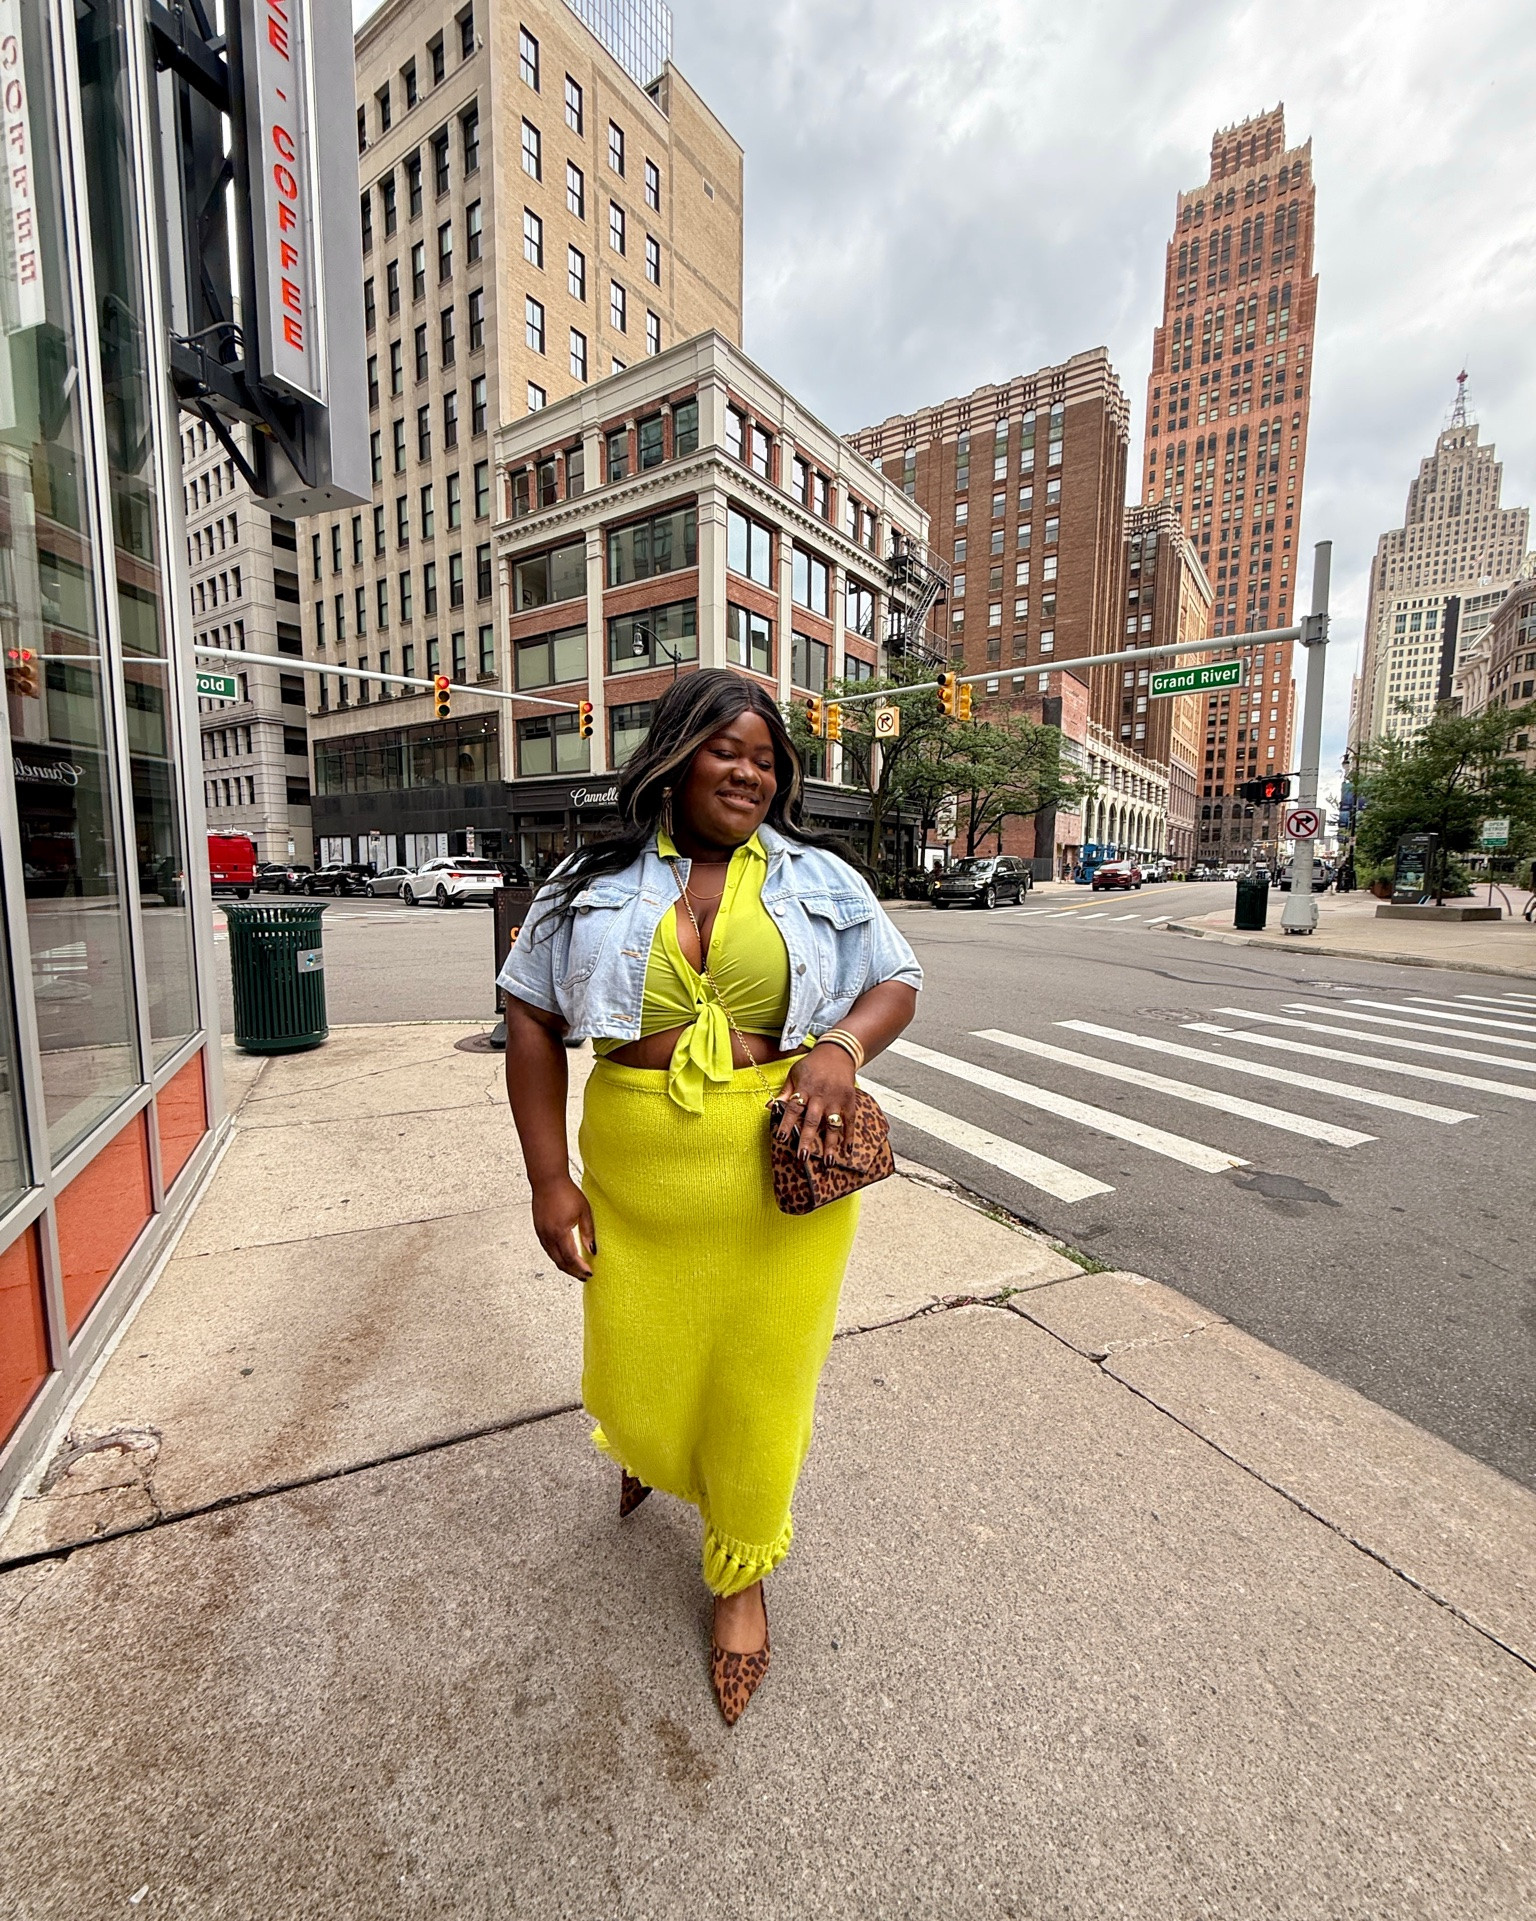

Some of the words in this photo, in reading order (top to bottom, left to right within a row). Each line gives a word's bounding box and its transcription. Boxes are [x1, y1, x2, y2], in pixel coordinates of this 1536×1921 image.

[272, 125, 304, 352] COFFEE
[1154, 672, 1195, 690] Grand
[1201, 668, 1238, 684] River
